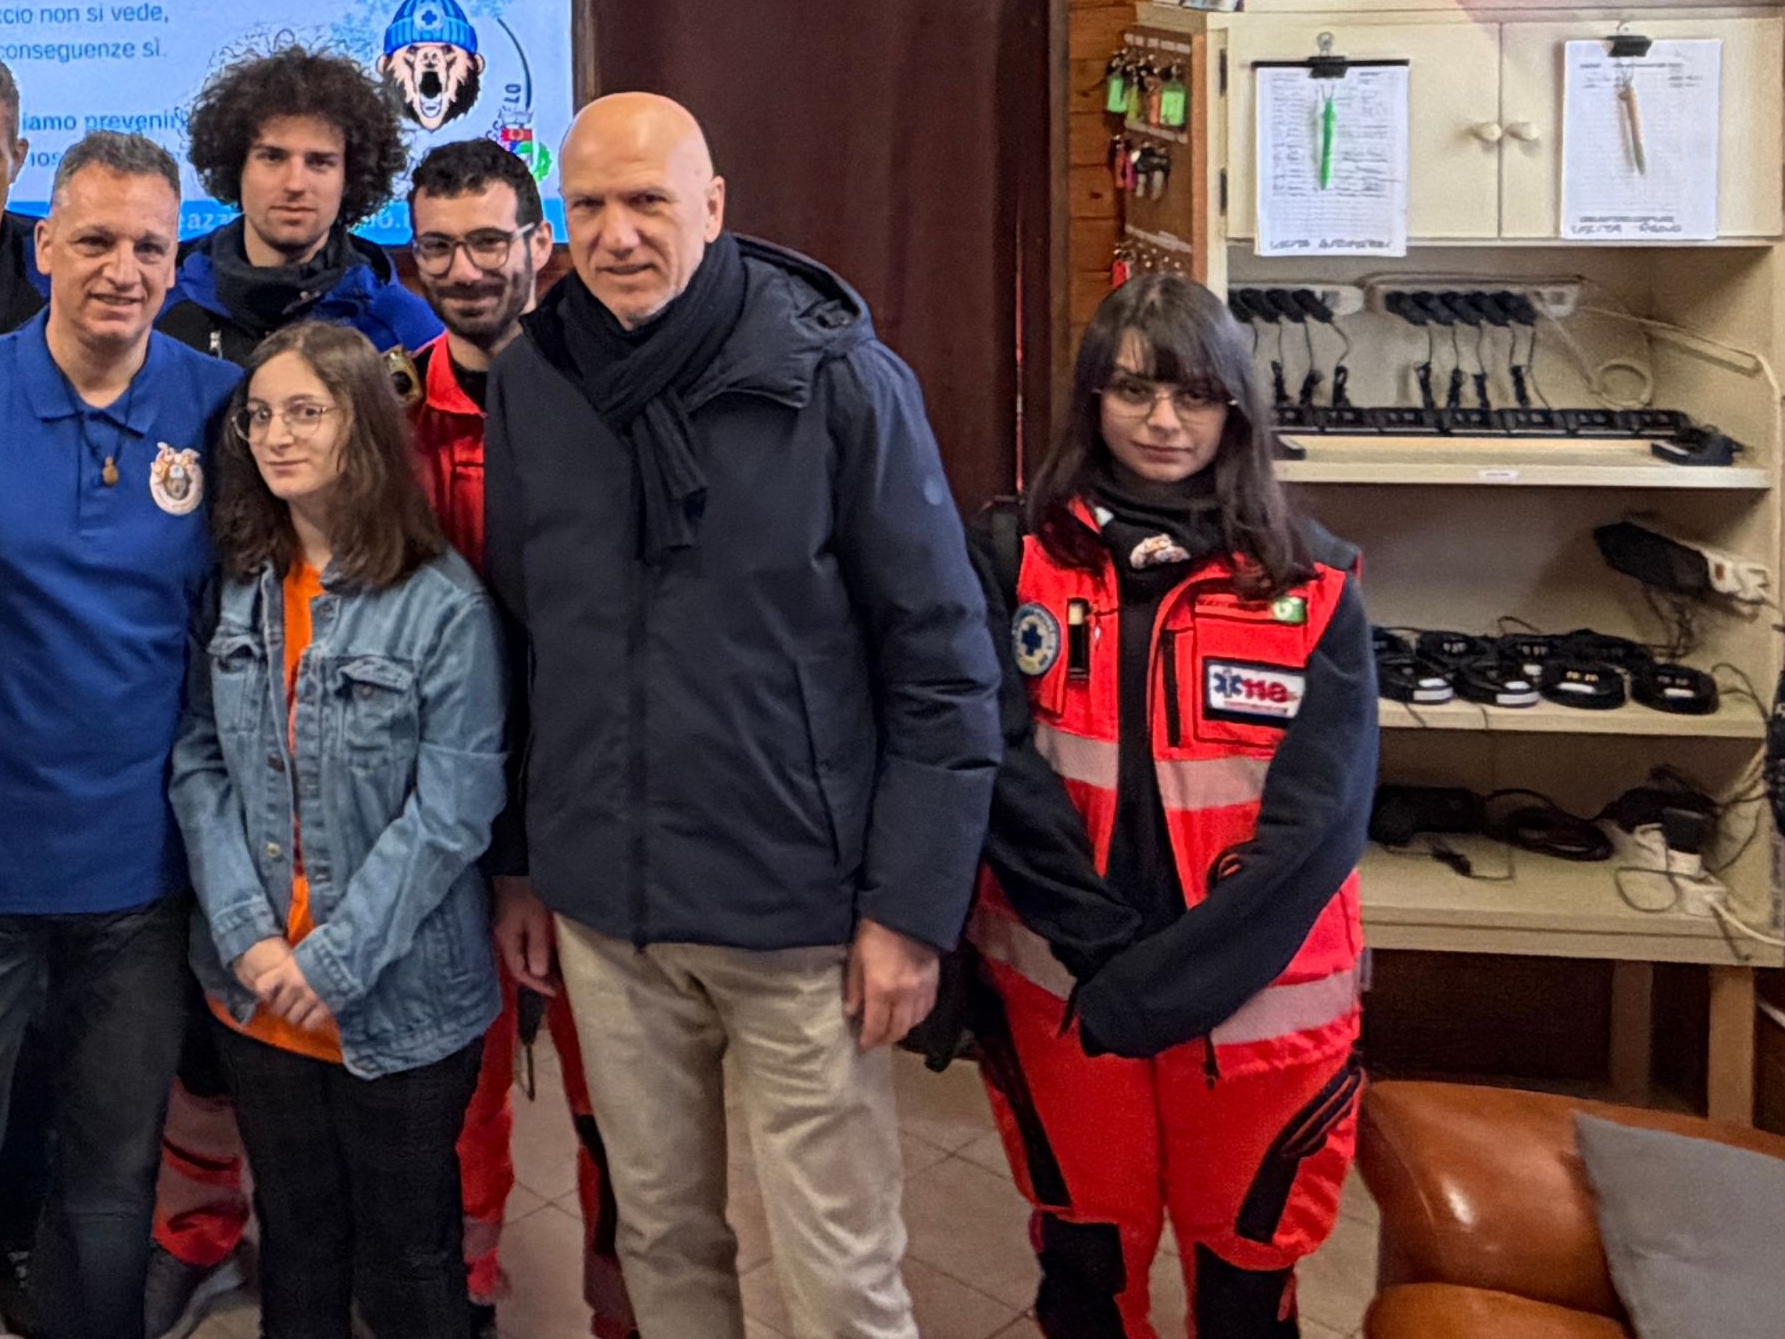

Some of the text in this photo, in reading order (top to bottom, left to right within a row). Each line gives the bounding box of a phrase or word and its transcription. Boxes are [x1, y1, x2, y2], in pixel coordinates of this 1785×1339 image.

[40, 8, 79, 24] non
[87, 5, 104, 23] si
[111, 3, 169, 24] vede,
